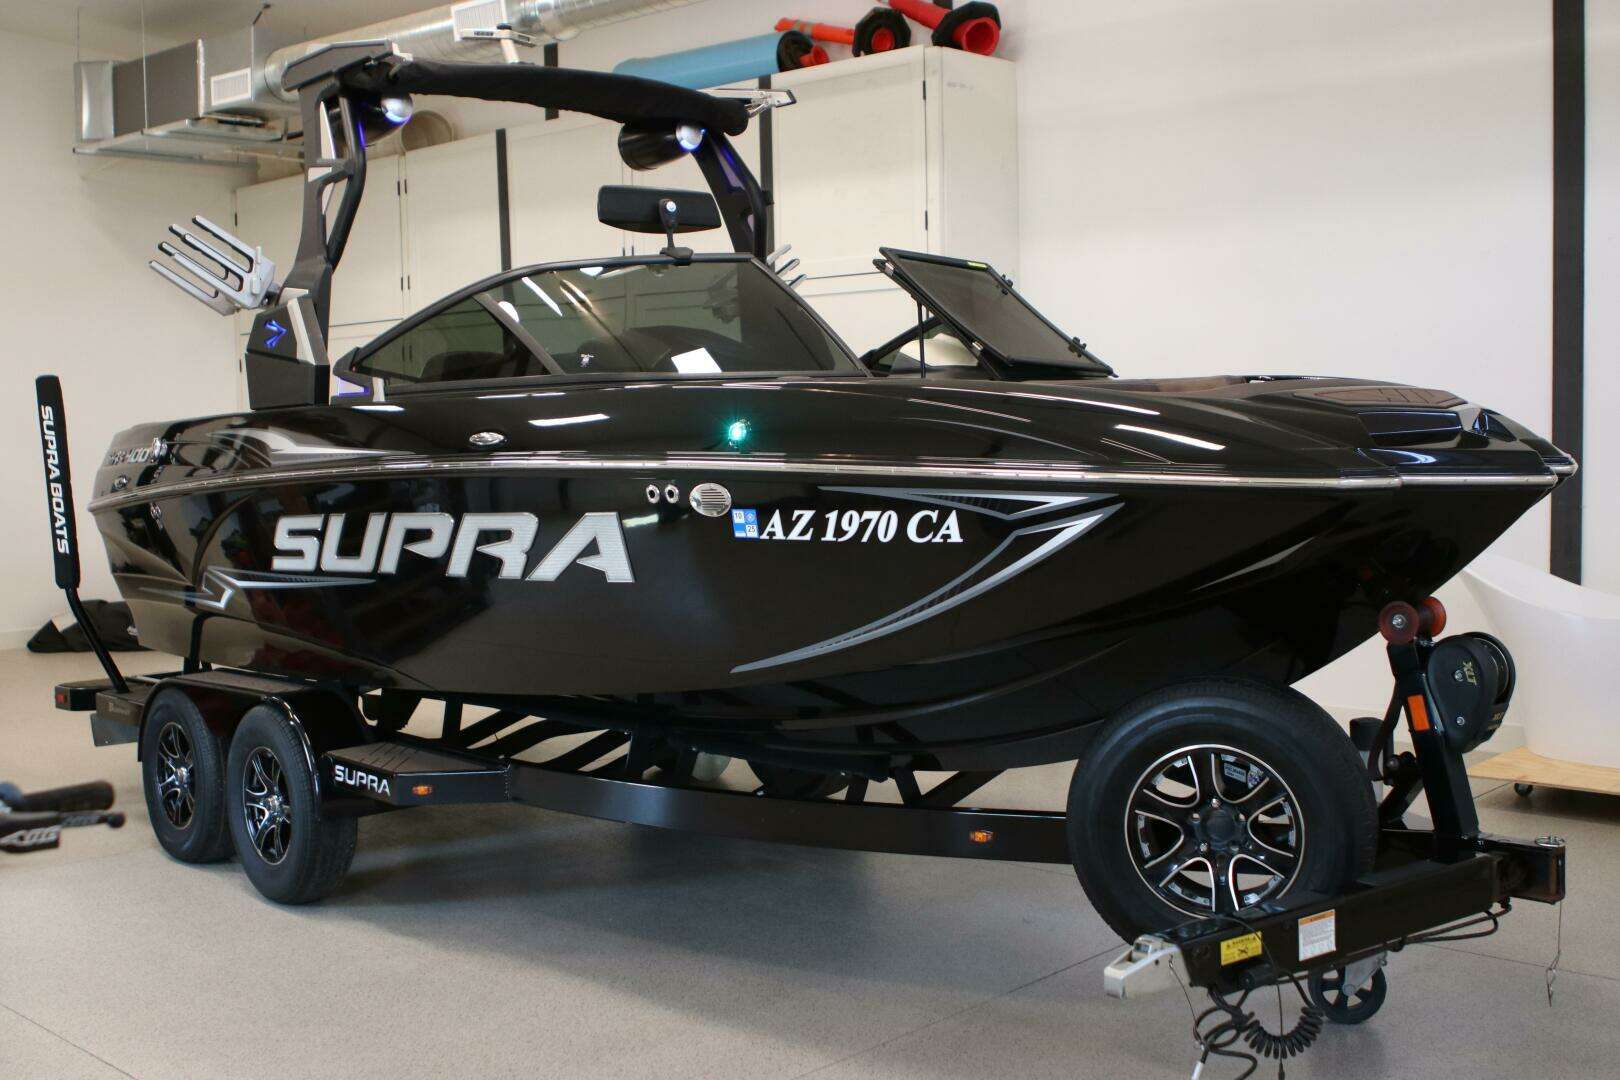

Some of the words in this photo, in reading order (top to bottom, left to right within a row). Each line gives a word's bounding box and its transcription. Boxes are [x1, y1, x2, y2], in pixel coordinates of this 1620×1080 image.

[41, 404, 61, 480] SUPRA
[50, 482, 70, 554] BOATS
[747, 525, 756, 533] 25
[760, 509, 816, 541] AZ
[821, 509, 899, 543] 1970
[906, 509, 963, 543] CA
[271, 512, 634, 583] SUPRA
[335, 764, 391, 797] SUPRA
